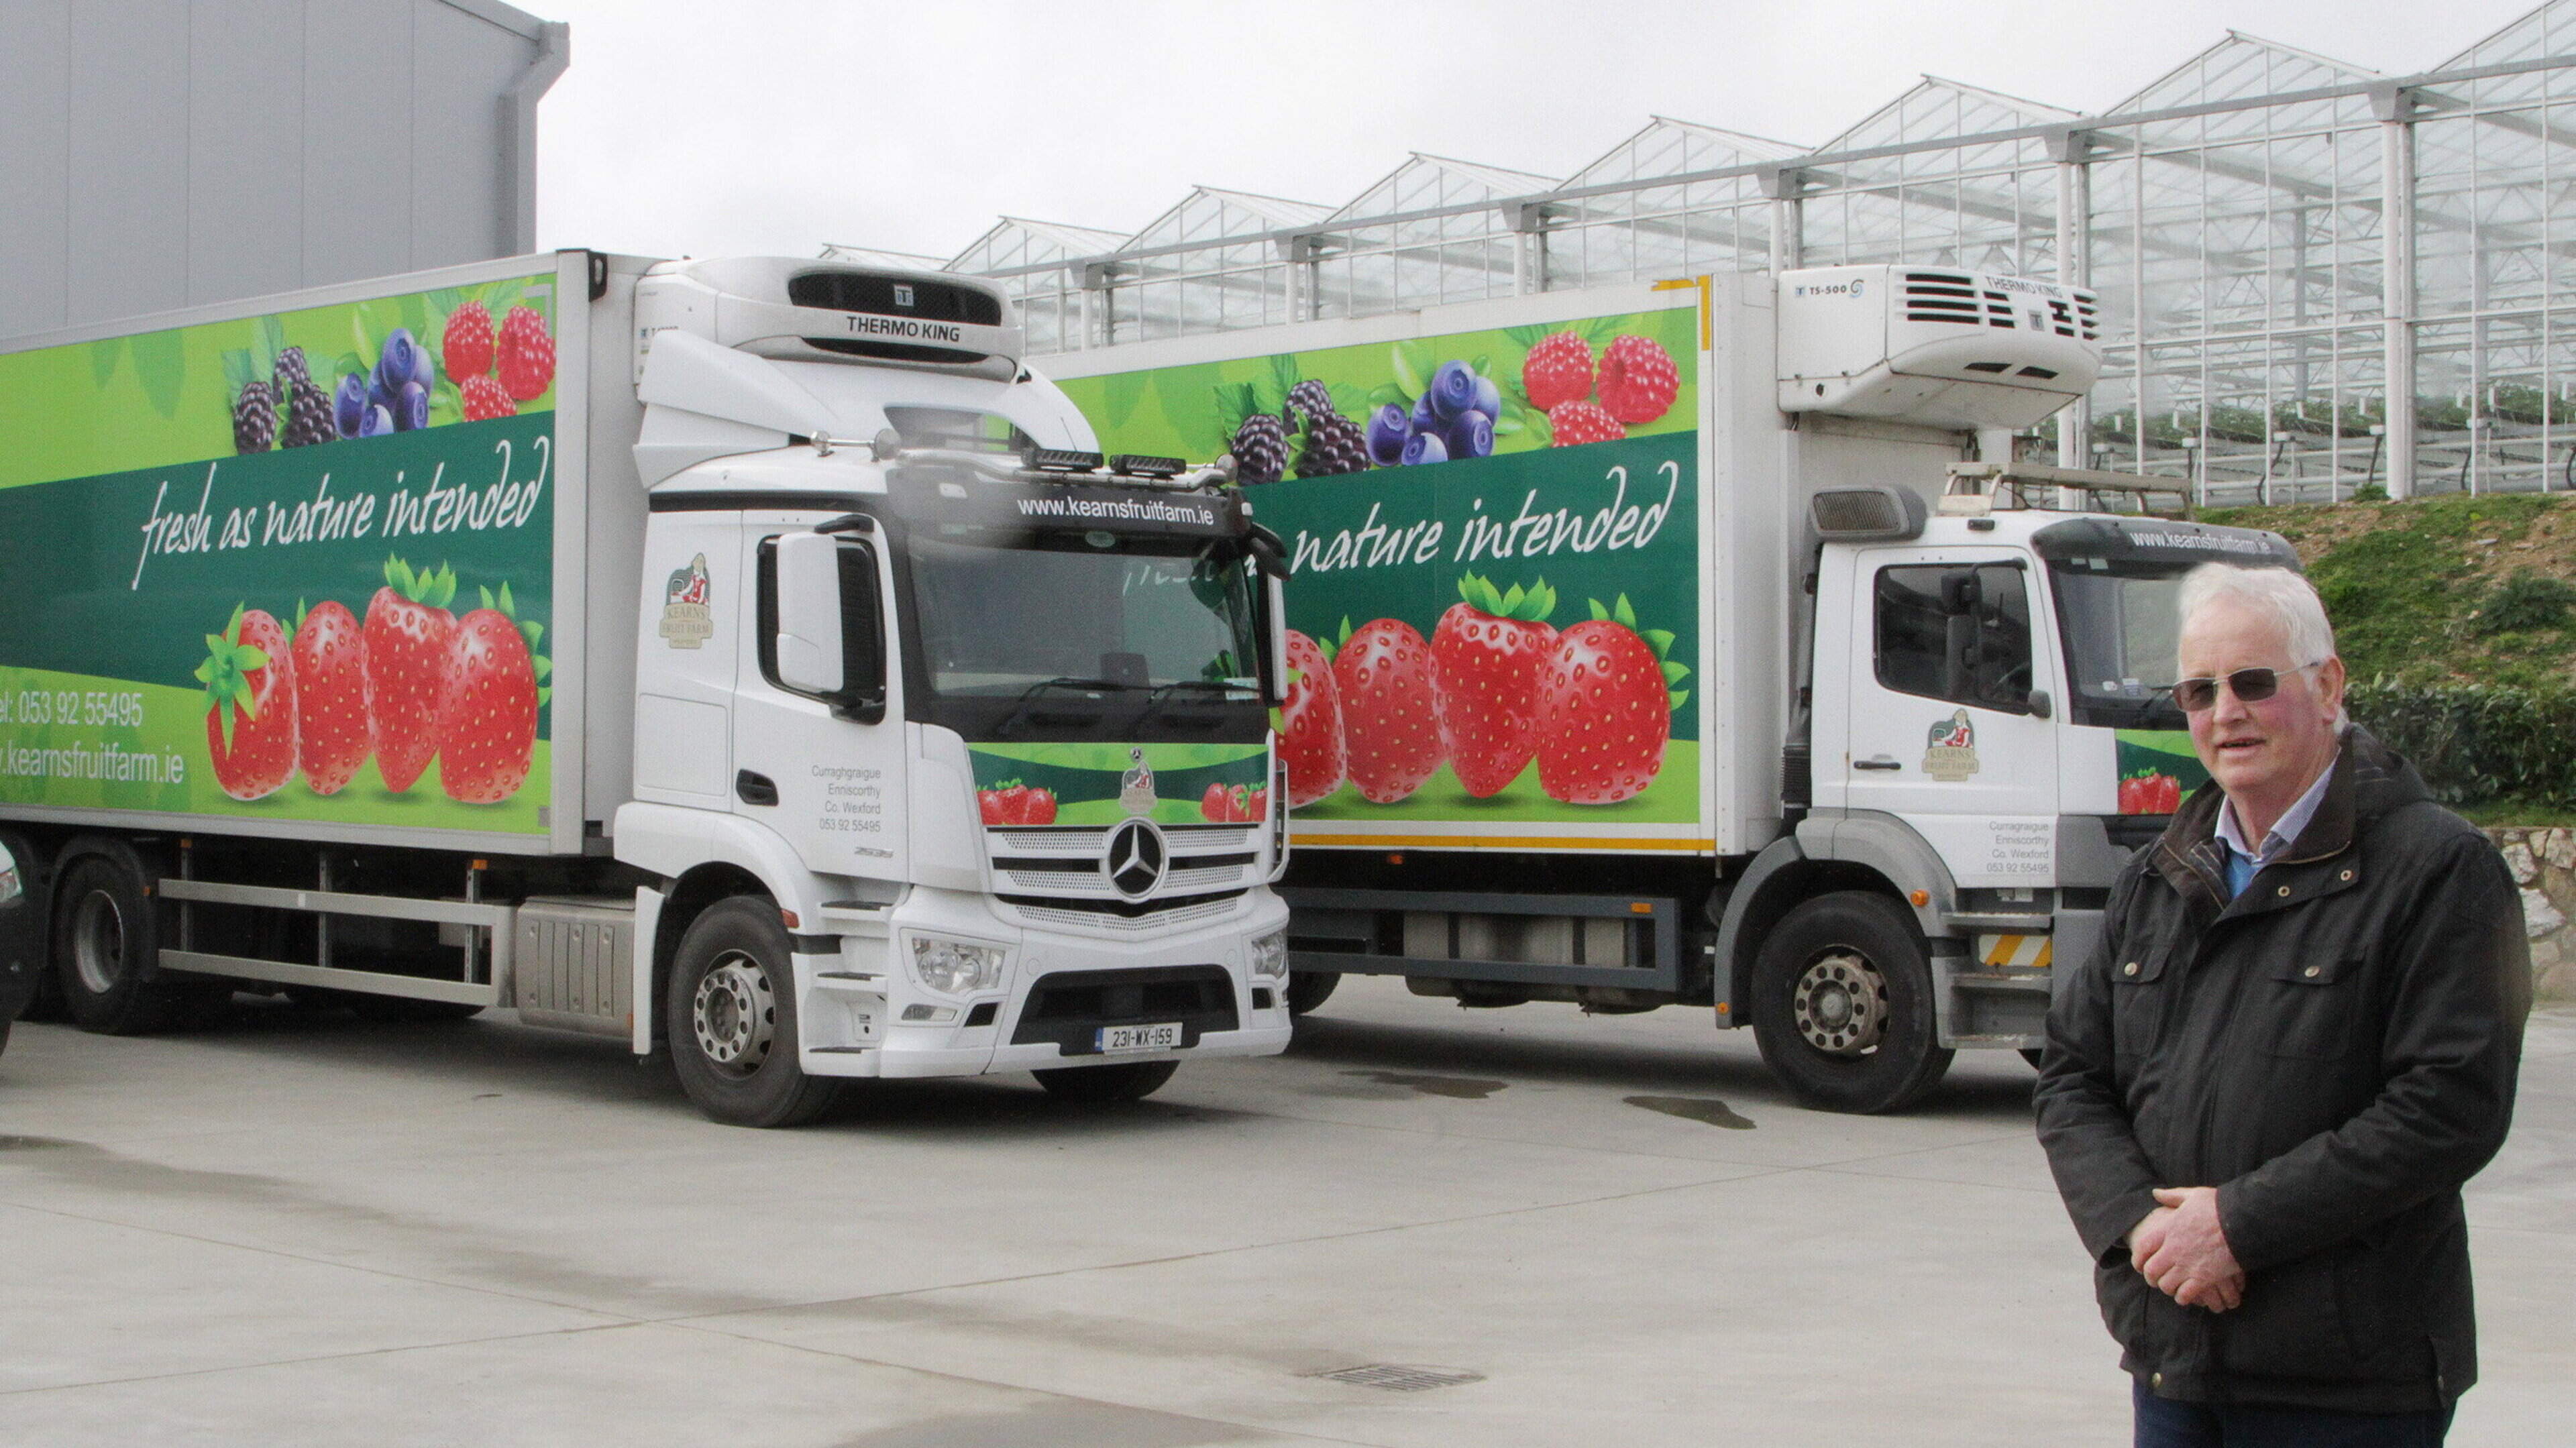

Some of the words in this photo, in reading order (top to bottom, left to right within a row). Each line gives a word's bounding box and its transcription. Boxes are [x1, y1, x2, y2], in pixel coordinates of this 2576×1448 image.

[1809, 284, 1847, 295] TS-500
[1986, 276, 2035, 294] THERMO
[2035, 284, 2063, 298] KING
[847, 316, 918, 337] THERMO
[922, 323, 961, 342] KING
[132, 462, 217, 590] fresh
[219, 507, 257, 549] as
[263, 474, 376, 546] nature
[382, 435, 550, 537] intended
[1017, 496, 1214, 525] www.kearnsfruitfarm.ie
[1289, 502, 1444, 575] nature
[1454, 460, 1679, 563] intended
[2130, 531, 2271, 555] www.kearnsfruitfarm.ie
[667, 606, 706, 620] KEARNS
[19, 691, 51, 724] 053
[56, 691, 80, 725] 92
[85, 692, 144, 726] 55495
[0, 740, 184, 784] .kearnsfruitfarm.ie
[812, 765, 881, 781] Curraghgraigue
[828, 783, 881, 799] Enniscorthy
[825, 800, 839, 813] Co.
[843, 801, 881, 815] Wexford
[820, 818, 836, 830] 053
[838, 819, 849, 831] 92
[852, 820, 881, 832] 55495
[1996, 835, 2049, 847] Enniscorthy
[1992, 848, 2006, 858] Co.
[2010, 848, 2049, 858] Wexford
[1986, 862, 2003, 872] 053
[2006, 862, 2018, 873] 92
[2020, 862, 2049, 873] 55495
[1112, 1028, 1173, 1048] 231-WX-159
